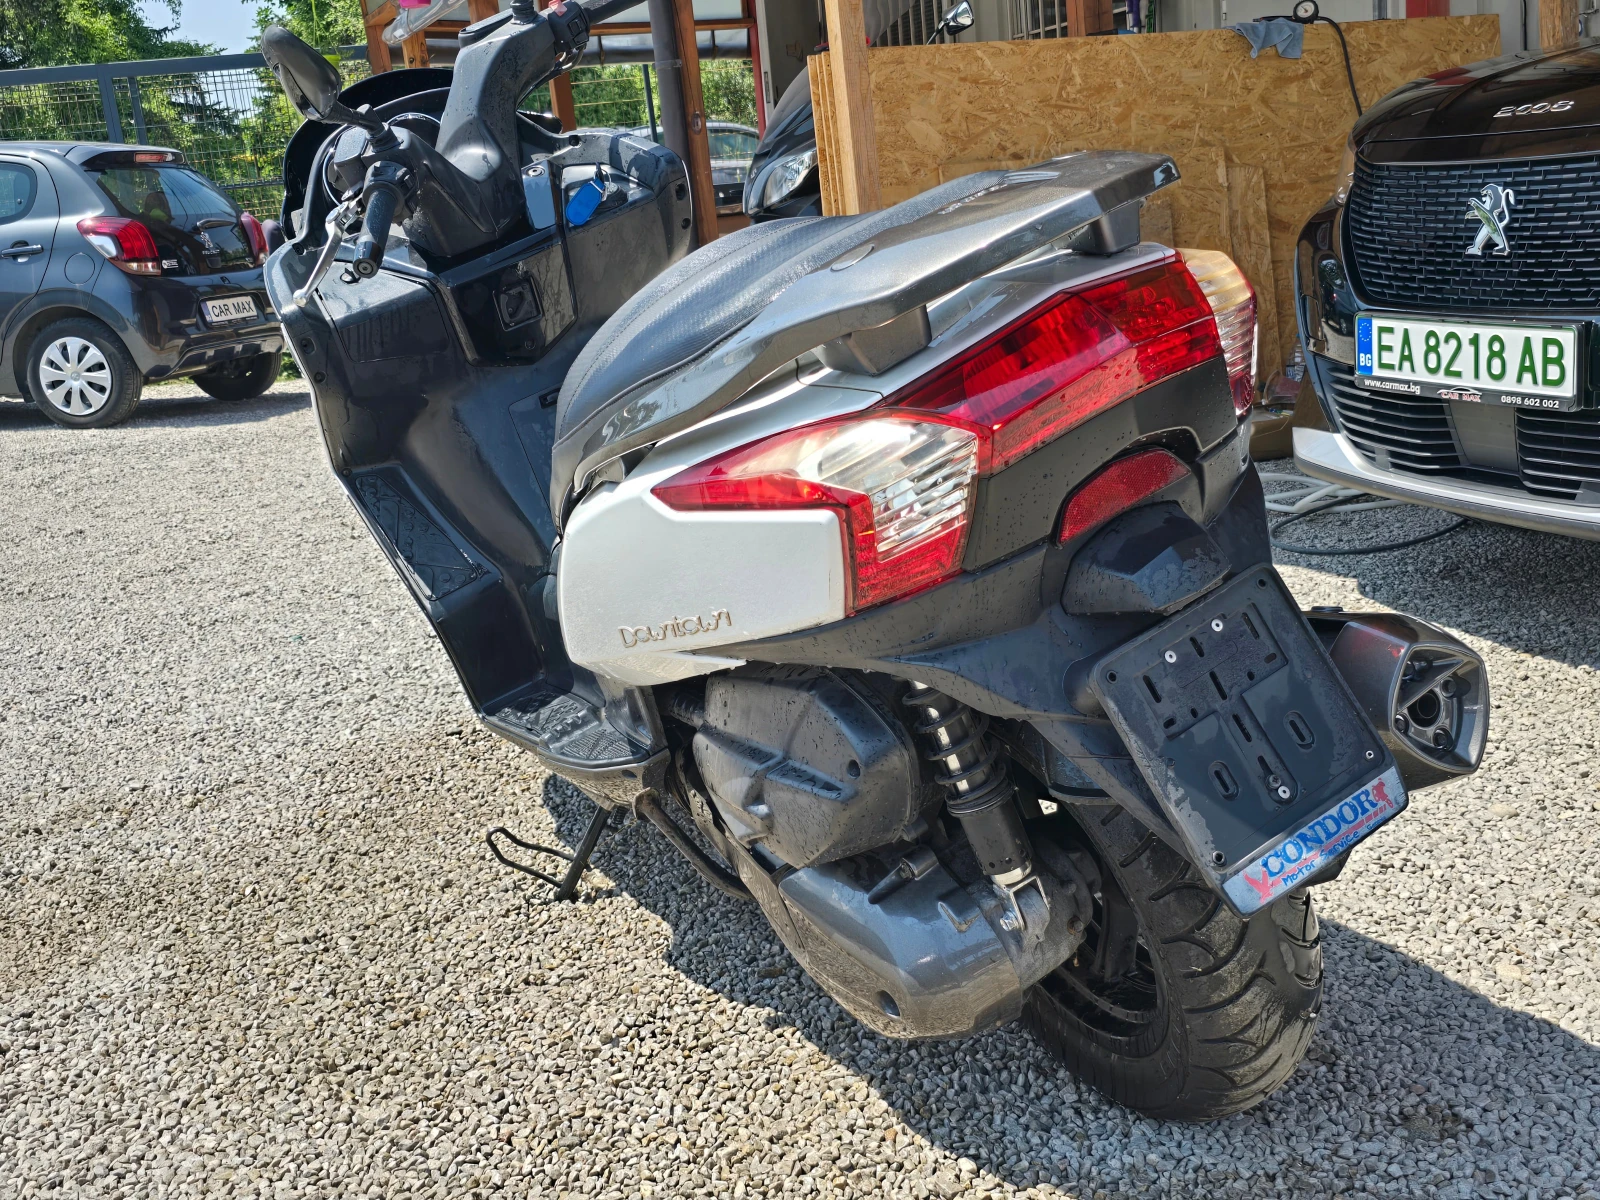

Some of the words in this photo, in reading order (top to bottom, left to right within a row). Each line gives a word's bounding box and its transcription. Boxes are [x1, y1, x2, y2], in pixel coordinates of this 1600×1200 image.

[1493, 100, 1575, 118] 2008
[211, 303, 232, 318] CAR
[232, 300, 254, 315] MAX
[1359, 353, 1372, 366] BG
[1377, 326, 1415, 373] EA
[1423, 329, 1506, 381] 8218
[1516, 336, 1566, 387] AB
[1364, 378, 1421, 395] www.carmax.bg
[1441, 391, 1459, 400] CAR
[1462, 393, 1481, 403] MAX
[1500, 395, 1522, 405] 0898
[1523, 397, 1540, 407] 602
[1542, 399, 1559, 409] 002
[618, 608, 732, 648] Downtown
[1259, 788, 1378, 878] CONDOR
[1281, 859, 1316, 887] Motor
[1319, 830, 1360, 862] Service
